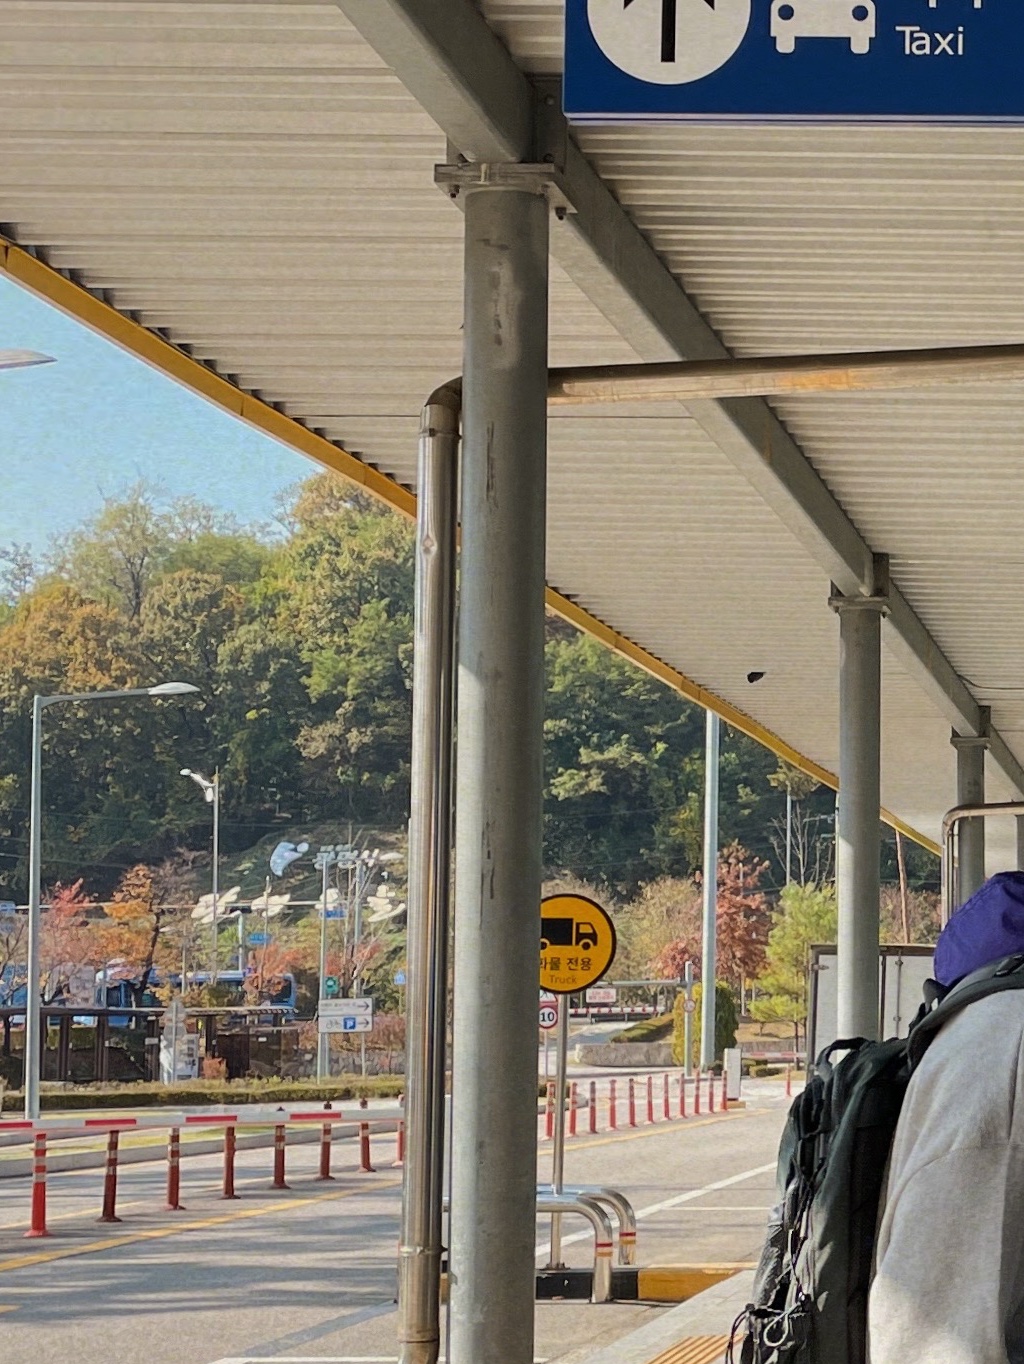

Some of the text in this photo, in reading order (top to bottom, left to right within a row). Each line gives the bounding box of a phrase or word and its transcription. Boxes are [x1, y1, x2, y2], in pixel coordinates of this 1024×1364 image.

[895, 25, 964, 56] Taxi
[566, 956, 592, 971] 전용
[549, 974, 578, 984] Truck
[540, 1011, 555, 1022] 10
